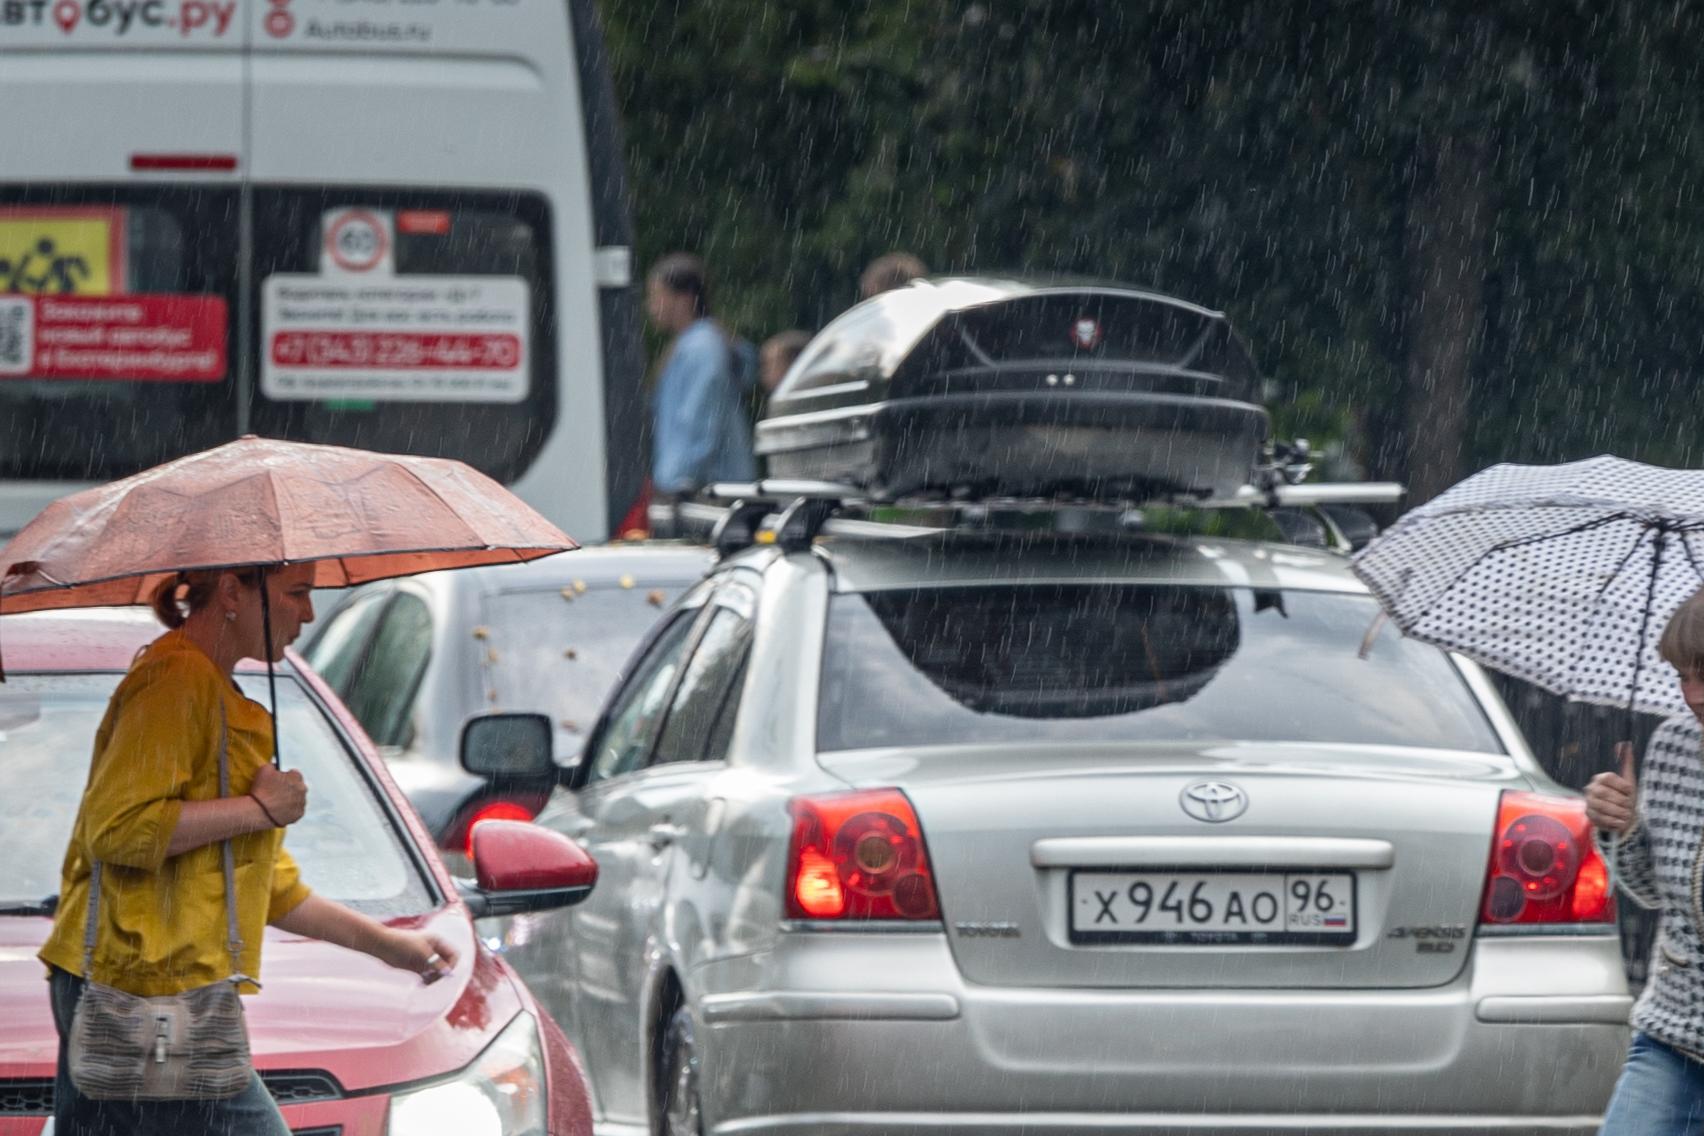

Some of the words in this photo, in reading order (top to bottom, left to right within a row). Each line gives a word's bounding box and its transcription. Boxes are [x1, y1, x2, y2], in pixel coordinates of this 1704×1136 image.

[0, 0, 236, 37] втобус.ру
[1290, 880, 1335, 913] 96
[1287, 914, 1323, 926] RUS
